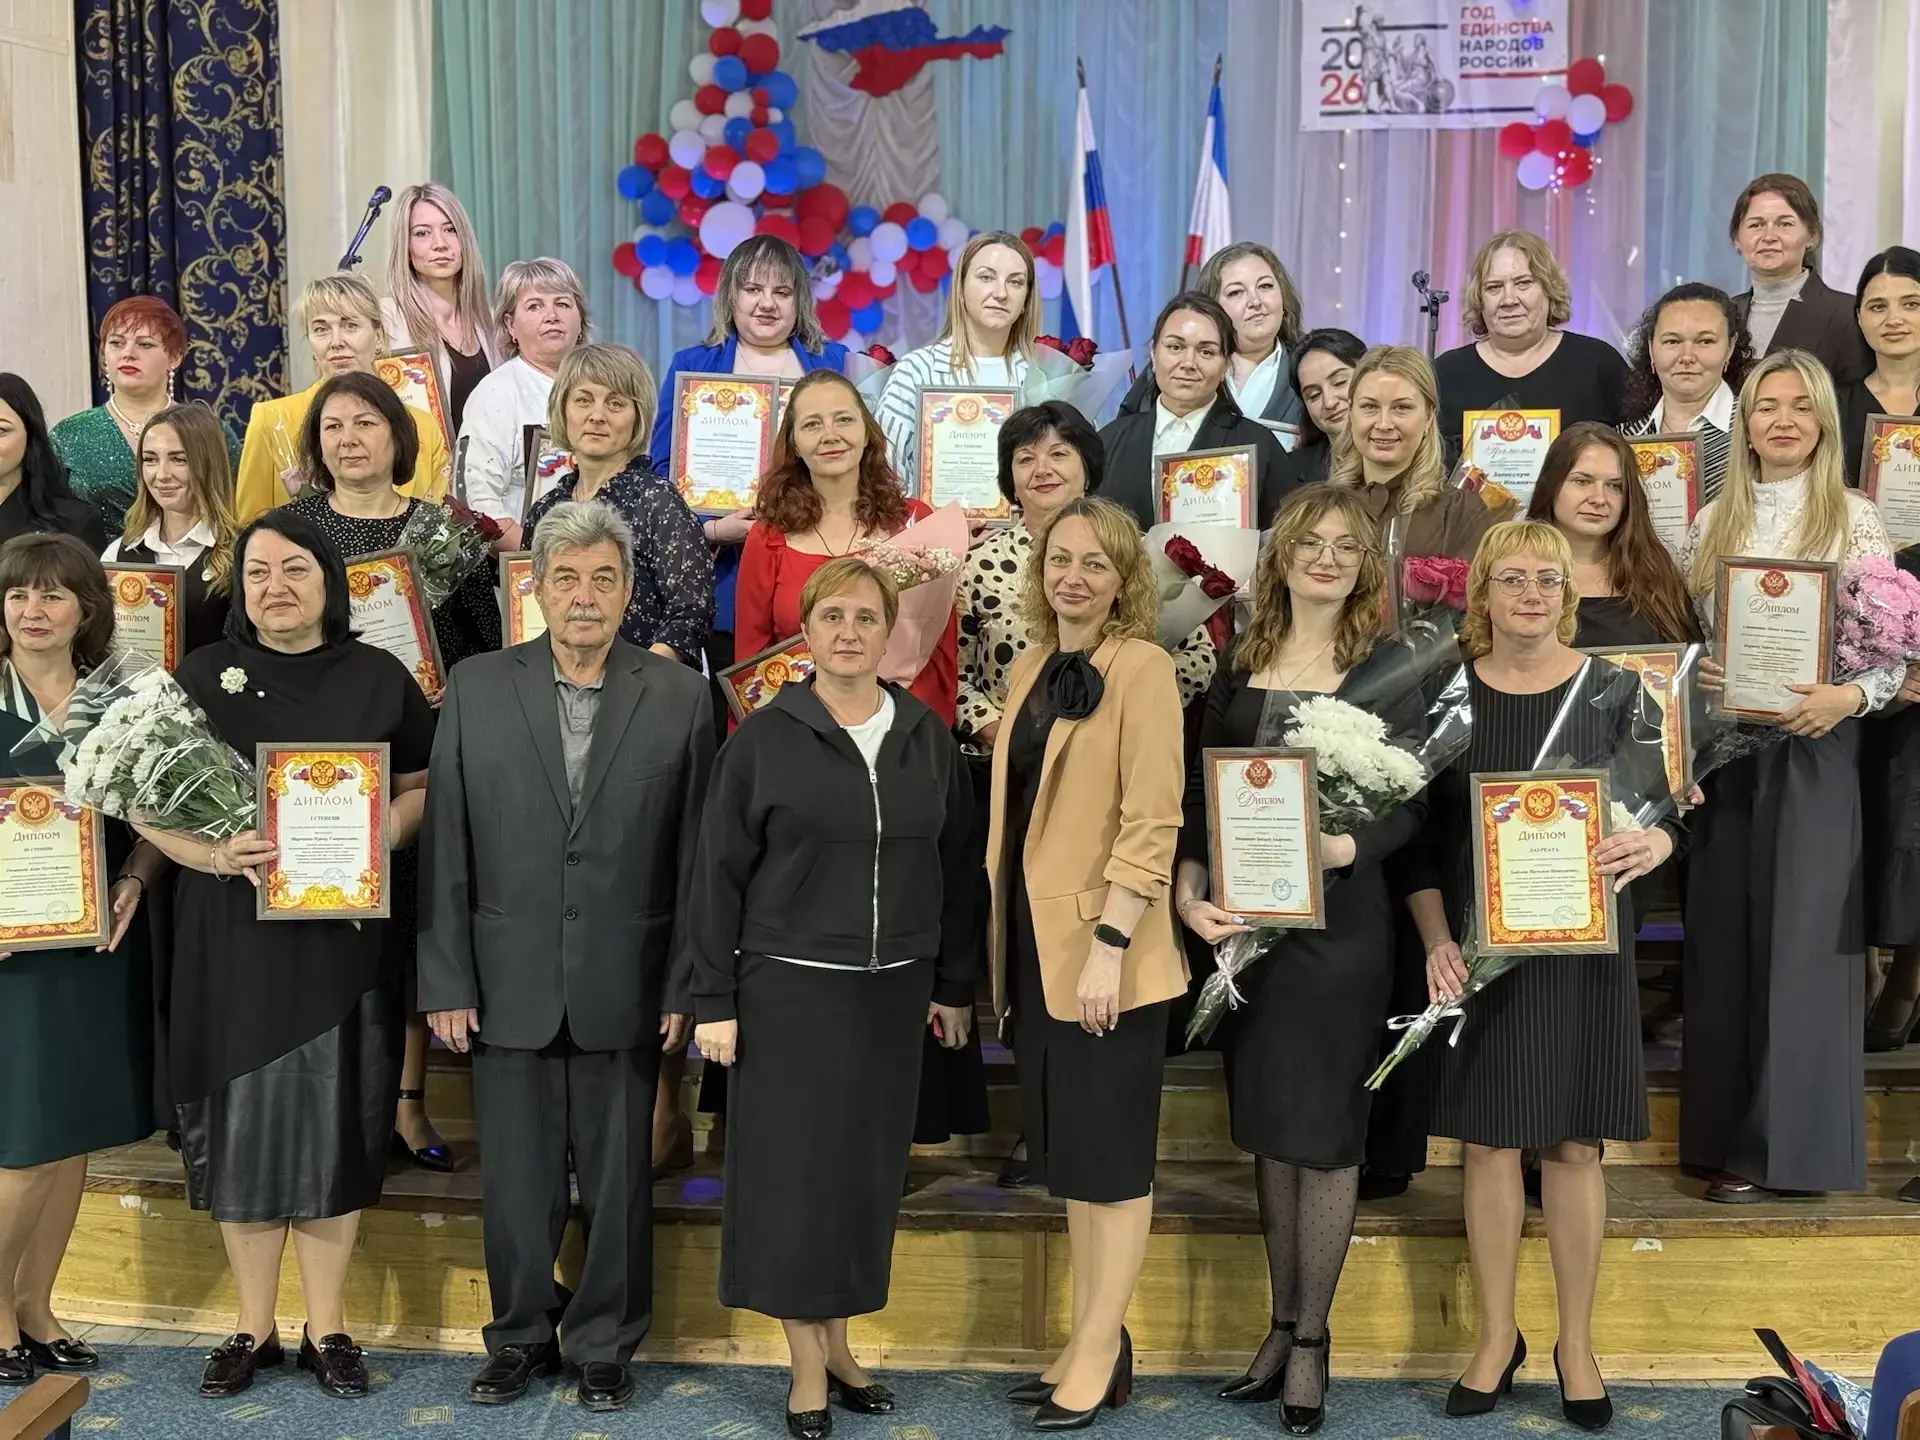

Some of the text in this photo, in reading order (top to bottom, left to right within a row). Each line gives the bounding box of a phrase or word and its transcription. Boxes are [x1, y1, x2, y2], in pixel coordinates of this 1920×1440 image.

[1461, 6, 1496, 20] ГОД
[1460, 21, 1554, 37] ЕДИНСТВА
[1460, 38, 1545, 53] НАРОДОВ
[1321, 37, 1365, 71] 20
[1459, 56, 1533, 69] РОССИИ
[1320, 73, 1364, 106] 26
[701, 417, 748, 426] ДИПЛОМ
[1484, 442, 1537, 459] Грамота
[1893, 464, 1920, 473] ДИП
[293, 795, 353, 806] ДИПЛОМ
